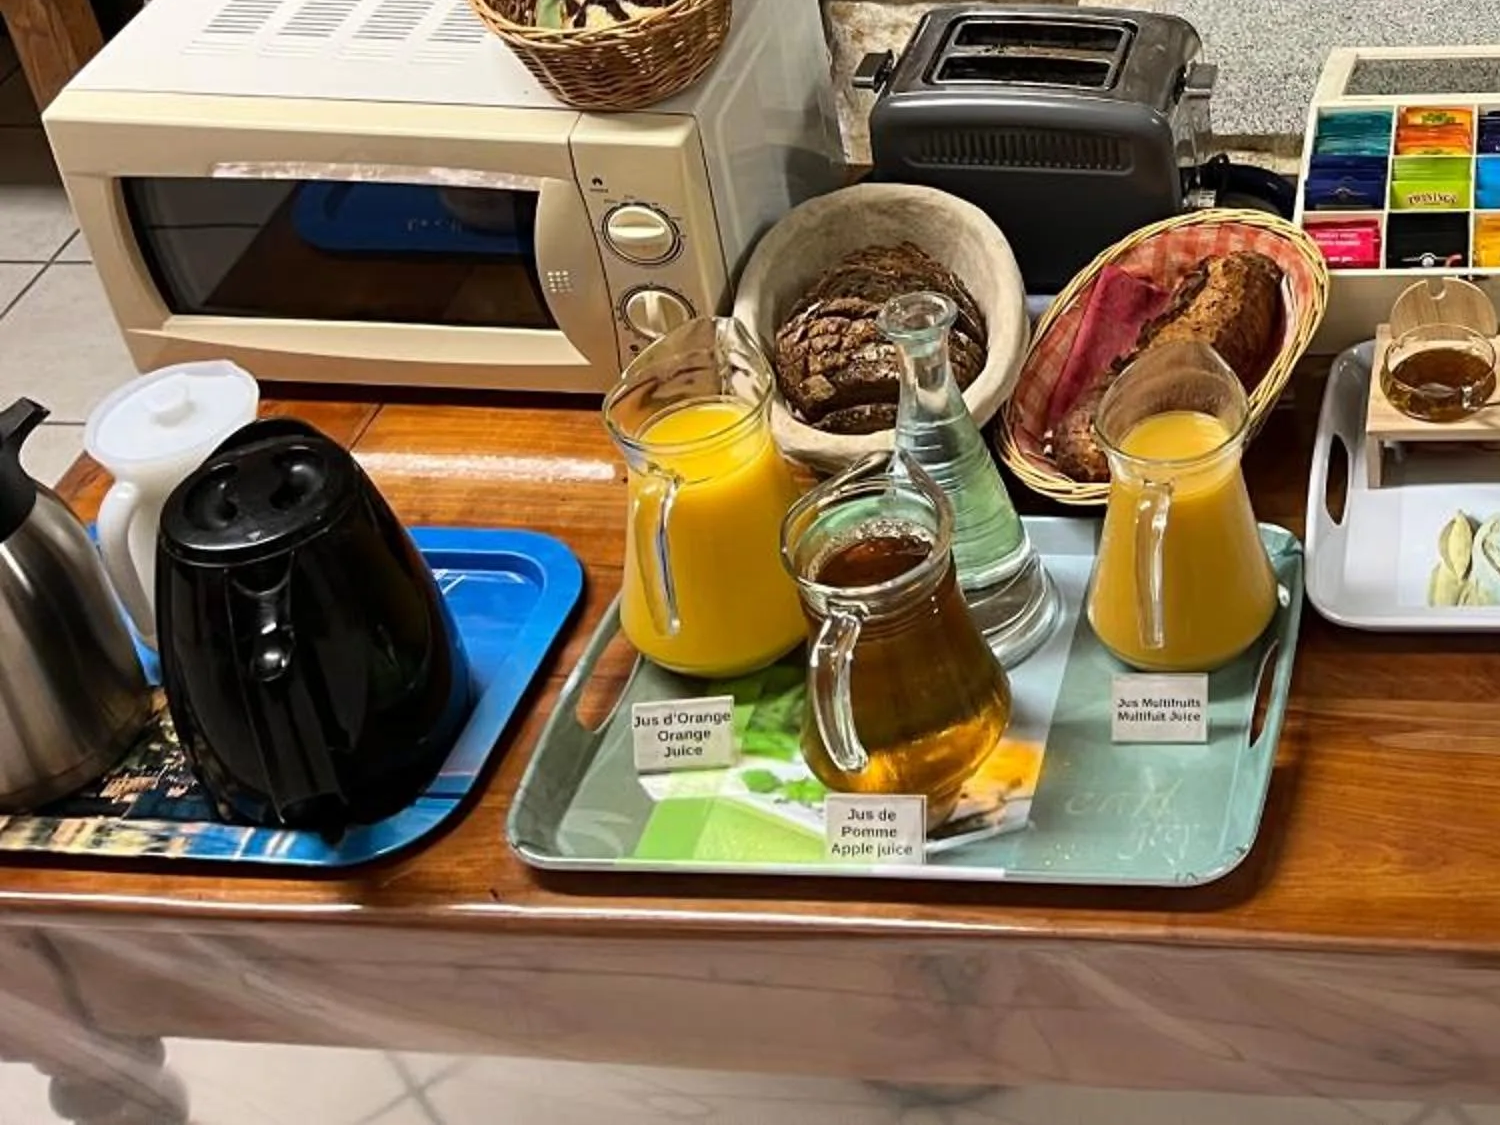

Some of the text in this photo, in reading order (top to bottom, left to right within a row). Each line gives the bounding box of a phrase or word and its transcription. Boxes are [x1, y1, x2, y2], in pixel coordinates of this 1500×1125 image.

[1117, 698, 1201, 708] Jus Multifruits
[633, 712, 732, 728] Jus d'Orange
[1169, 711, 1201, 722] Juice
[657, 730, 712, 742] Orange
[663, 745, 703, 758] Juice
[847, 807, 897, 821] Jus de
[841, 826, 897, 838] Pomme
[831, 842, 913, 858] Apple juice
